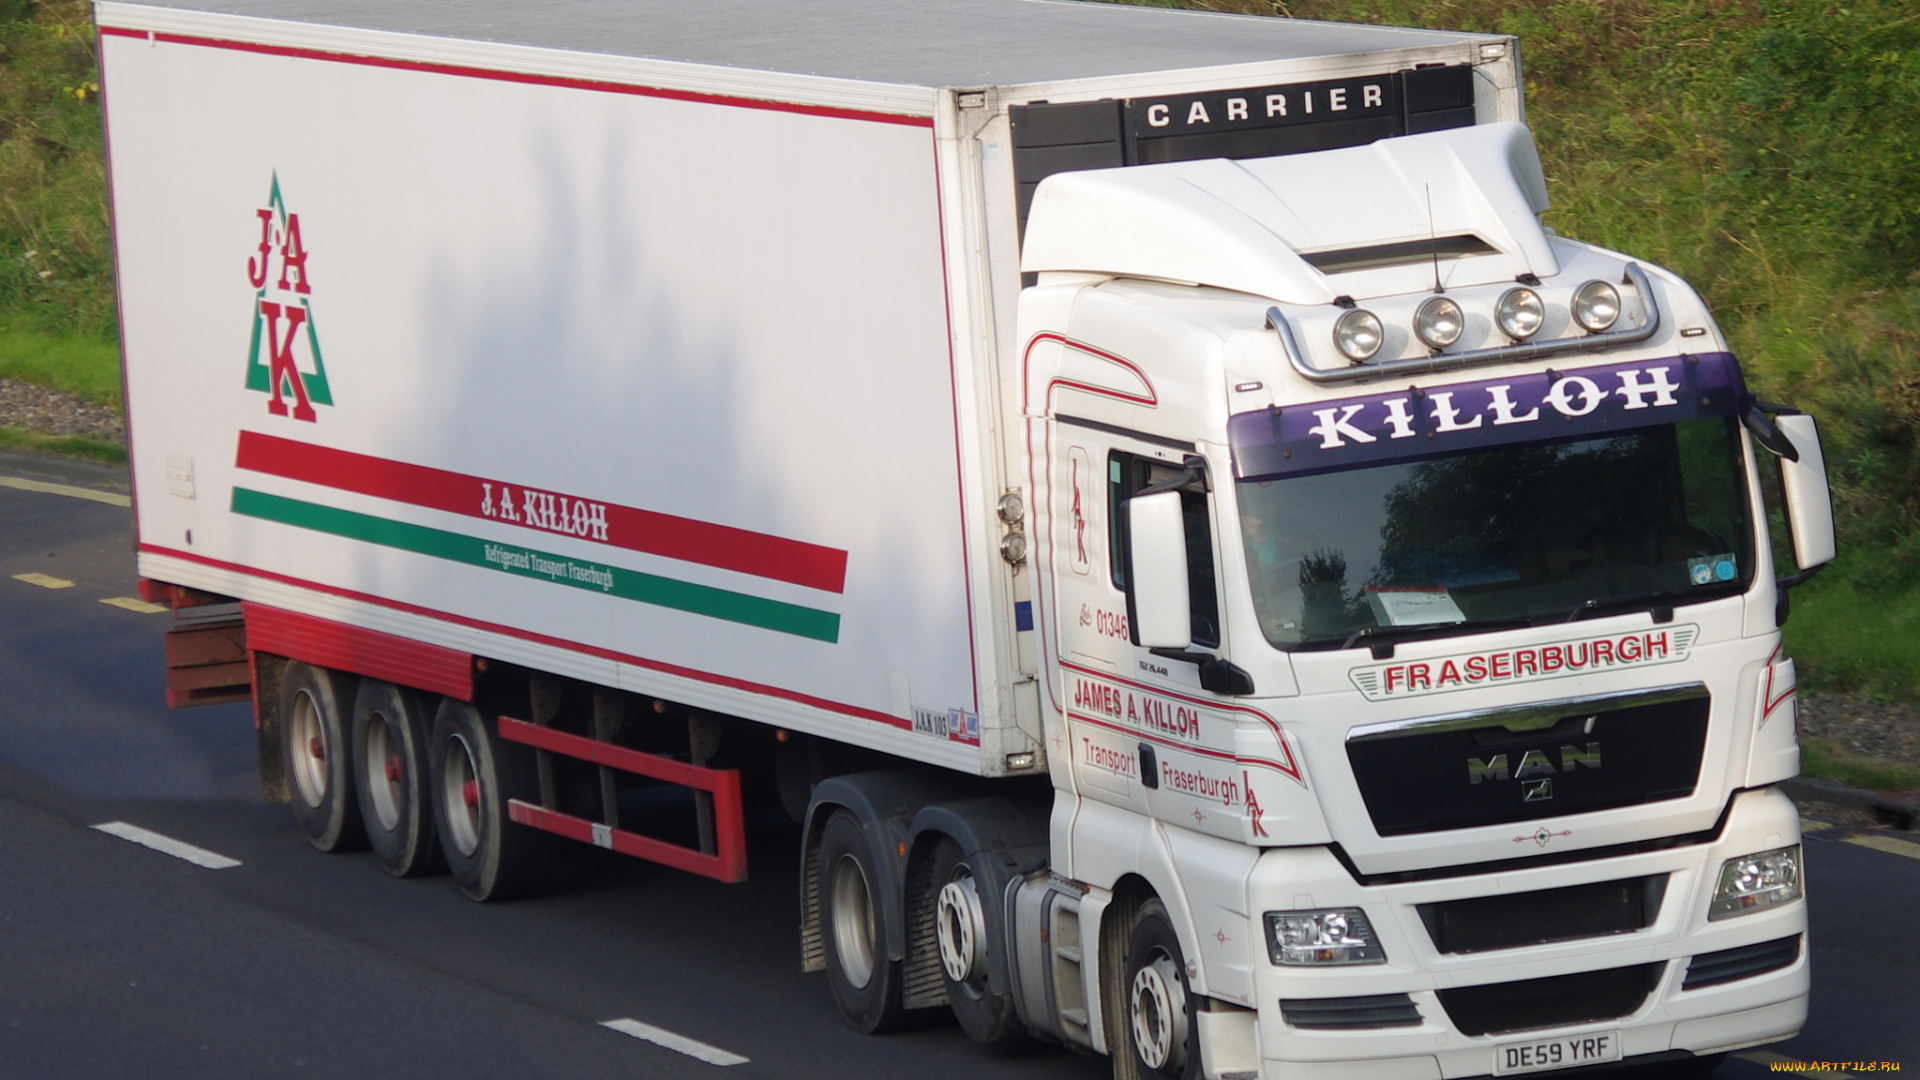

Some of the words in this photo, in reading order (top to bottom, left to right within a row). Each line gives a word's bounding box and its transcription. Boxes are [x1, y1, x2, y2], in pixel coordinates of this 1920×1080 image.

[1148, 84, 1383, 128] CARRIER
[1309, 366, 1680, 450] KILLOH
[522, 490, 608, 541] KILLOH
[484, 544, 530, 570] Refrigerated
[530, 554, 568, 580] Transport
[568, 562, 613, 591] Fraserburgh
[1096, 609, 1128, 641] 01346
[1384, 632, 1668, 695] FRASERBURGH
[1075, 678, 1122, 719] JAMES
[1143, 698, 1200, 741] KILLOH
[1083, 737, 1136, 775] Transport
[1162, 761, 1239, 806] Fraserburgh
[1468, 742, 1602, 785] MAN
[1506, 1043, 1562, 1068] DE59
[1569, 1036, 1609, 1061] YRF
